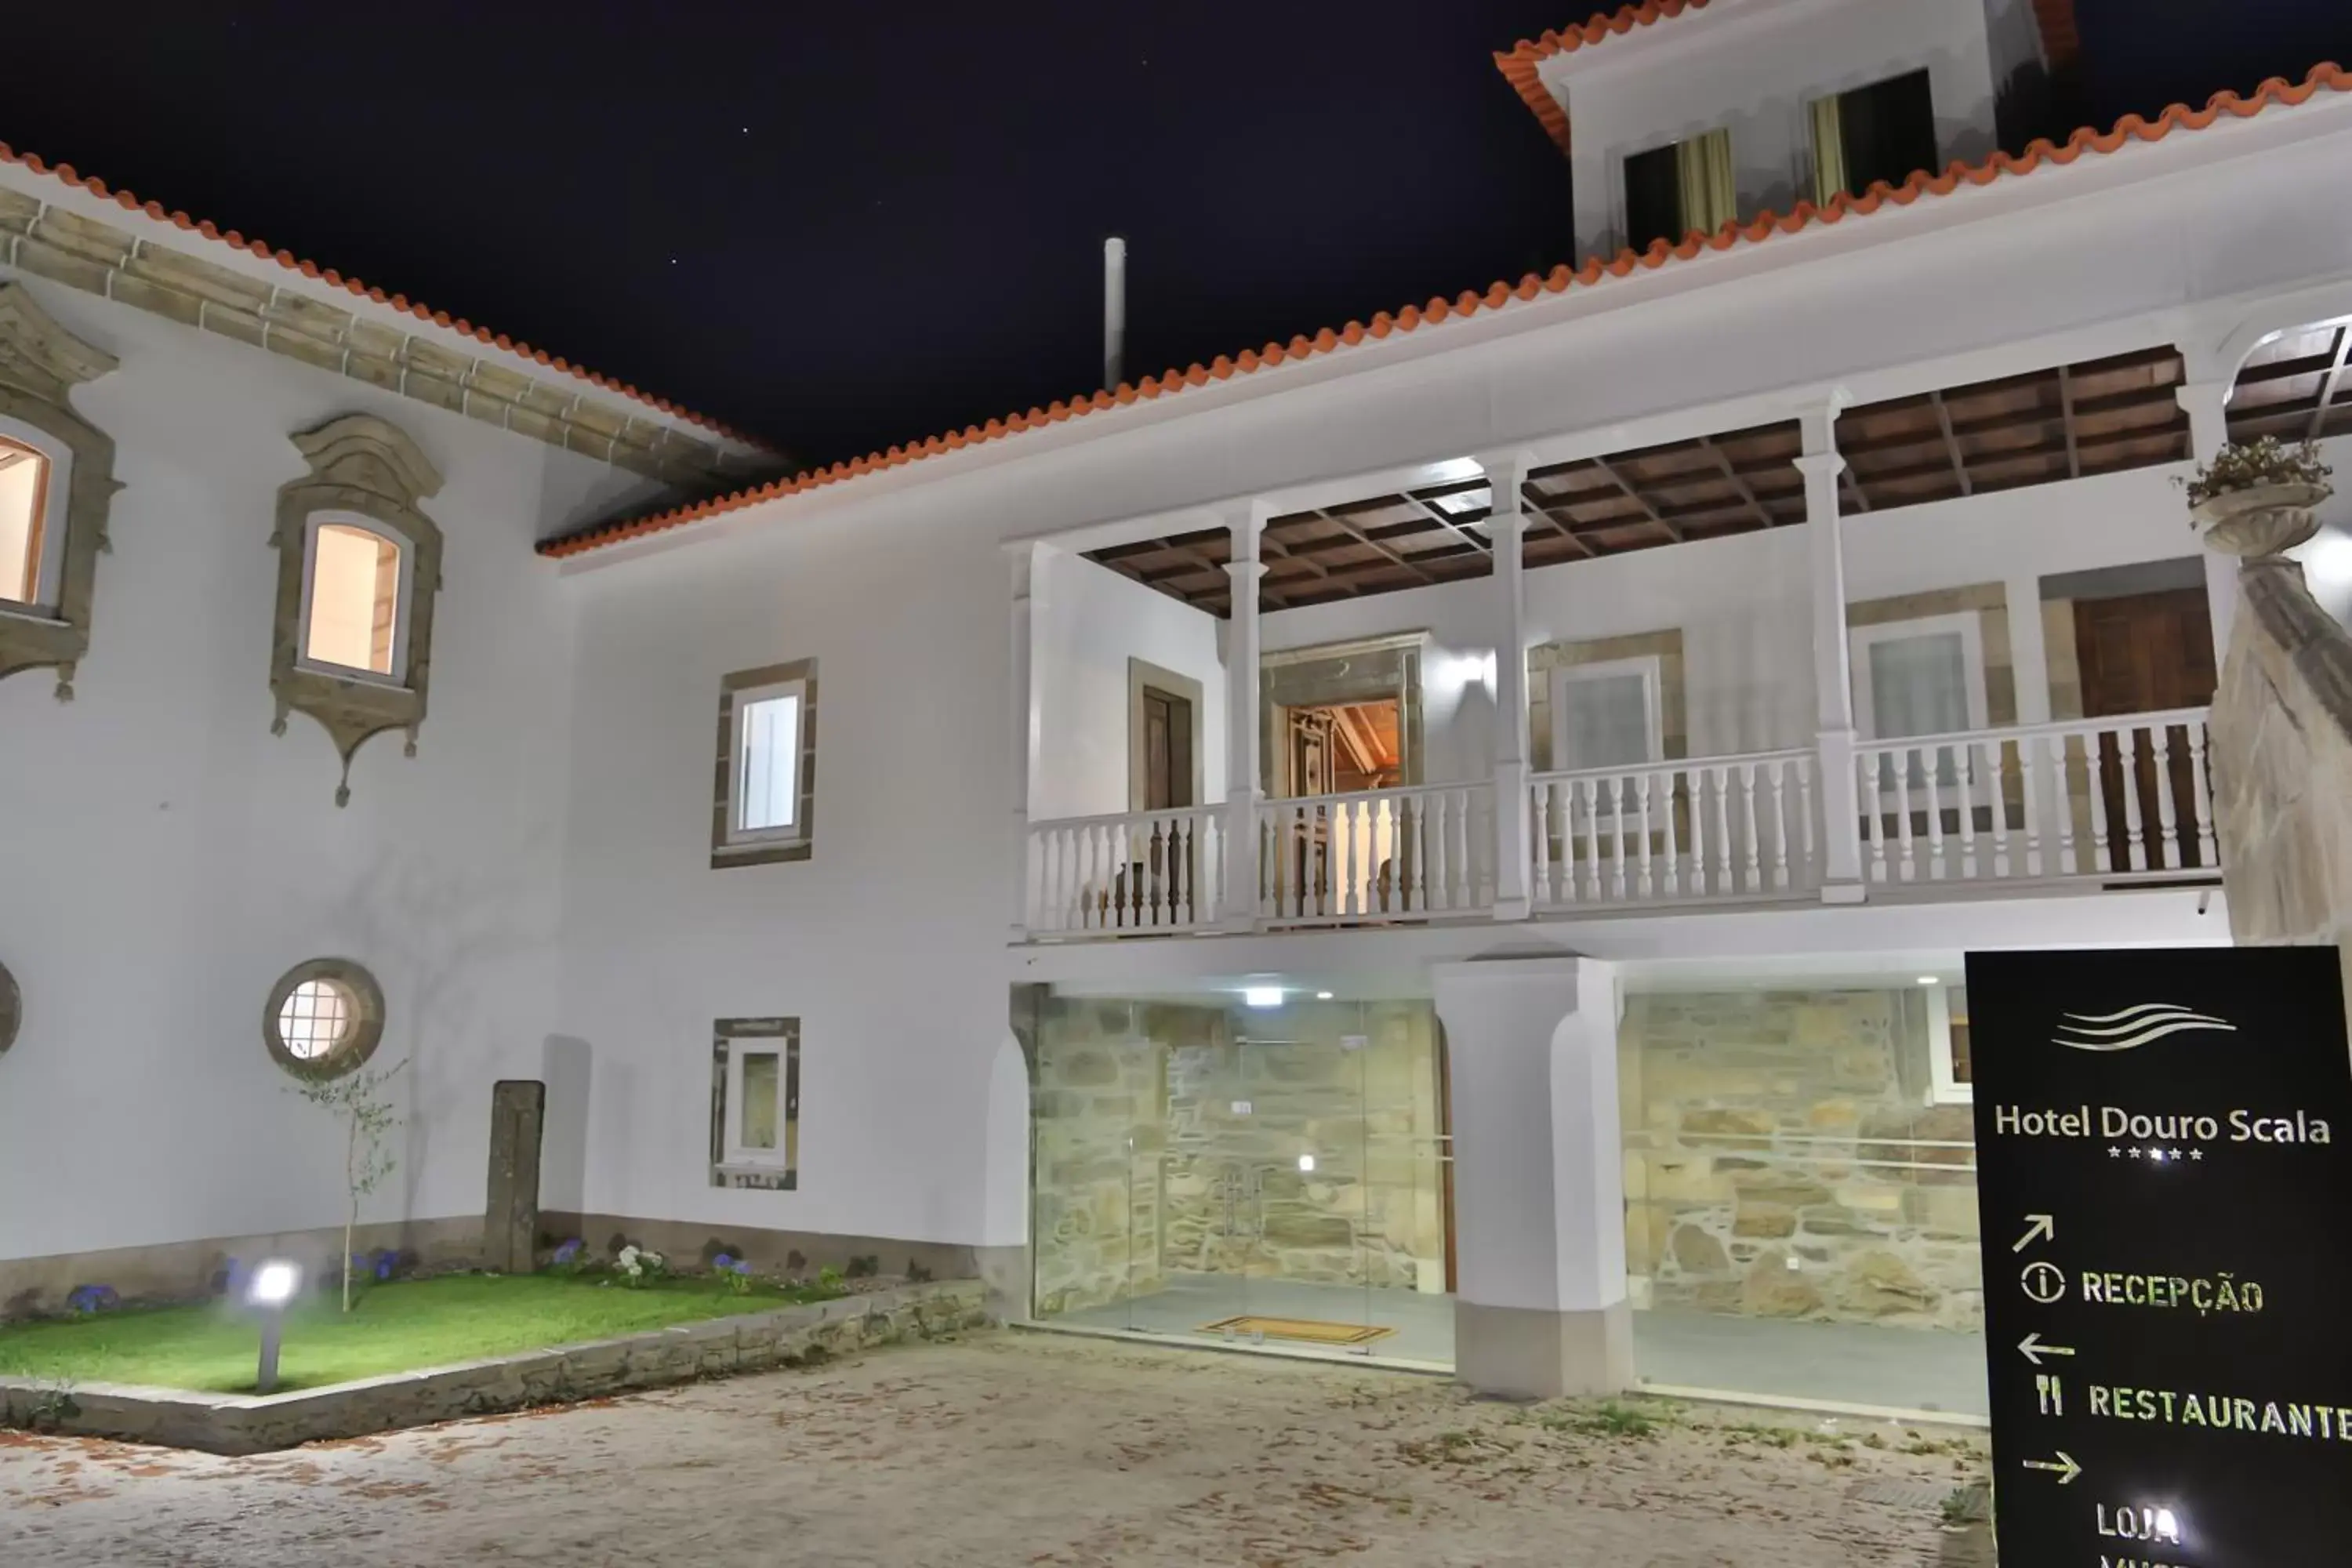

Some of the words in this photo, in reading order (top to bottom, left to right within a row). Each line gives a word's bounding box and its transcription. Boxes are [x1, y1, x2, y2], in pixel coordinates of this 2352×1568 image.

[1995, 1105, 2091, 1138] Hotel
[2101, 1106, 2219, 1142] Douro
[2229, 1109, 2331, 1144] Scala
[2082, 1271, 2263, 1316] RECEPÇÃO
[2089, 1385, 2352, 1441] RESTAURANTE
[2096, 1502, 2180, 1544] LOJA
